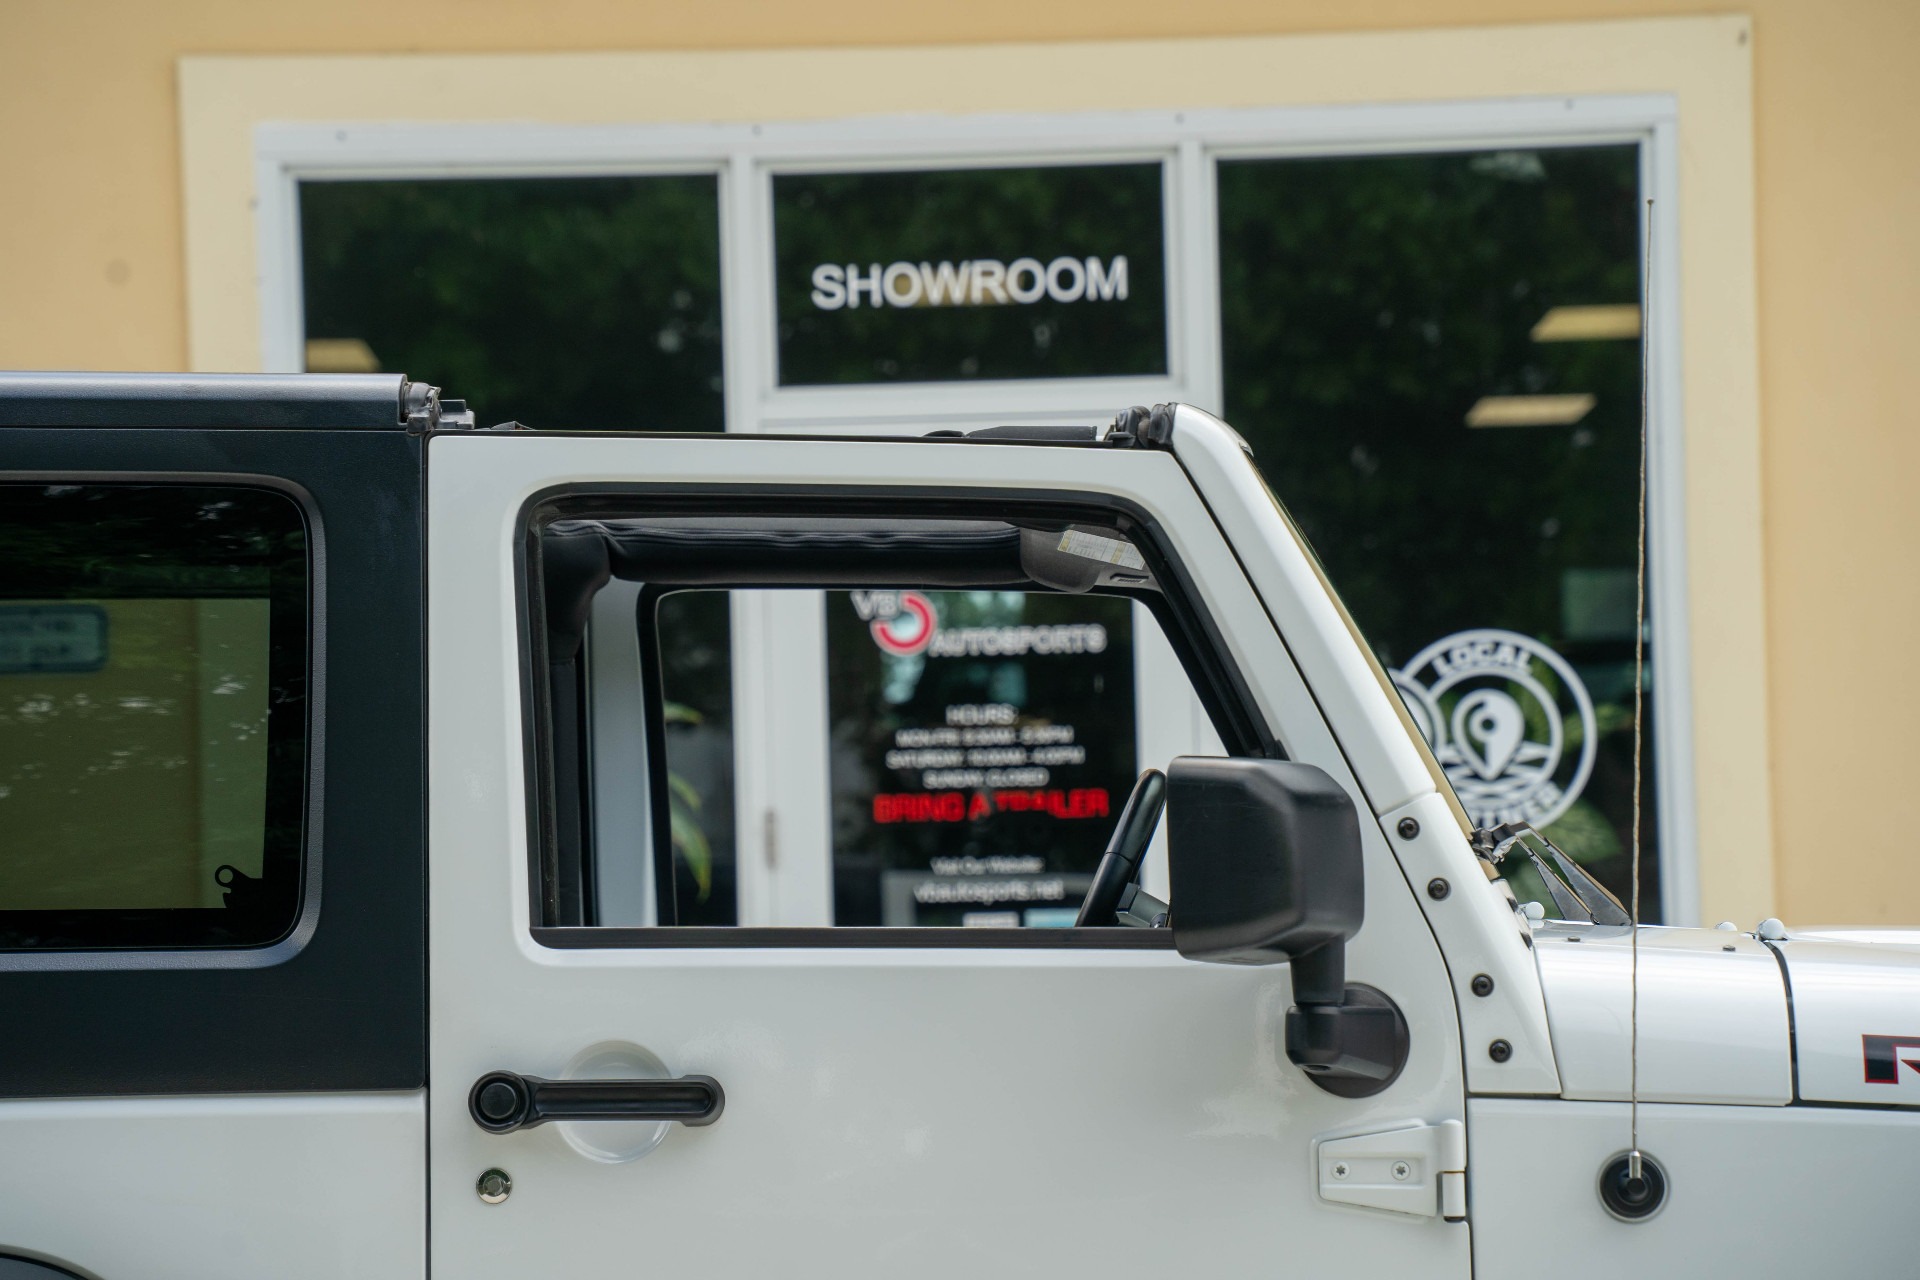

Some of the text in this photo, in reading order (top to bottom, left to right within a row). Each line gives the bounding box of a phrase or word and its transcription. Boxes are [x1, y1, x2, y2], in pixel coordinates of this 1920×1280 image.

[811, 255, 1128, 310] SHOWROOM
[928, 623, 1107, 657] AUTOSPORTS
[1431, 641, 1533, 673] LOCAL
[873, 792, 964, 823] BRING
[968, 791, 991, 820] A
